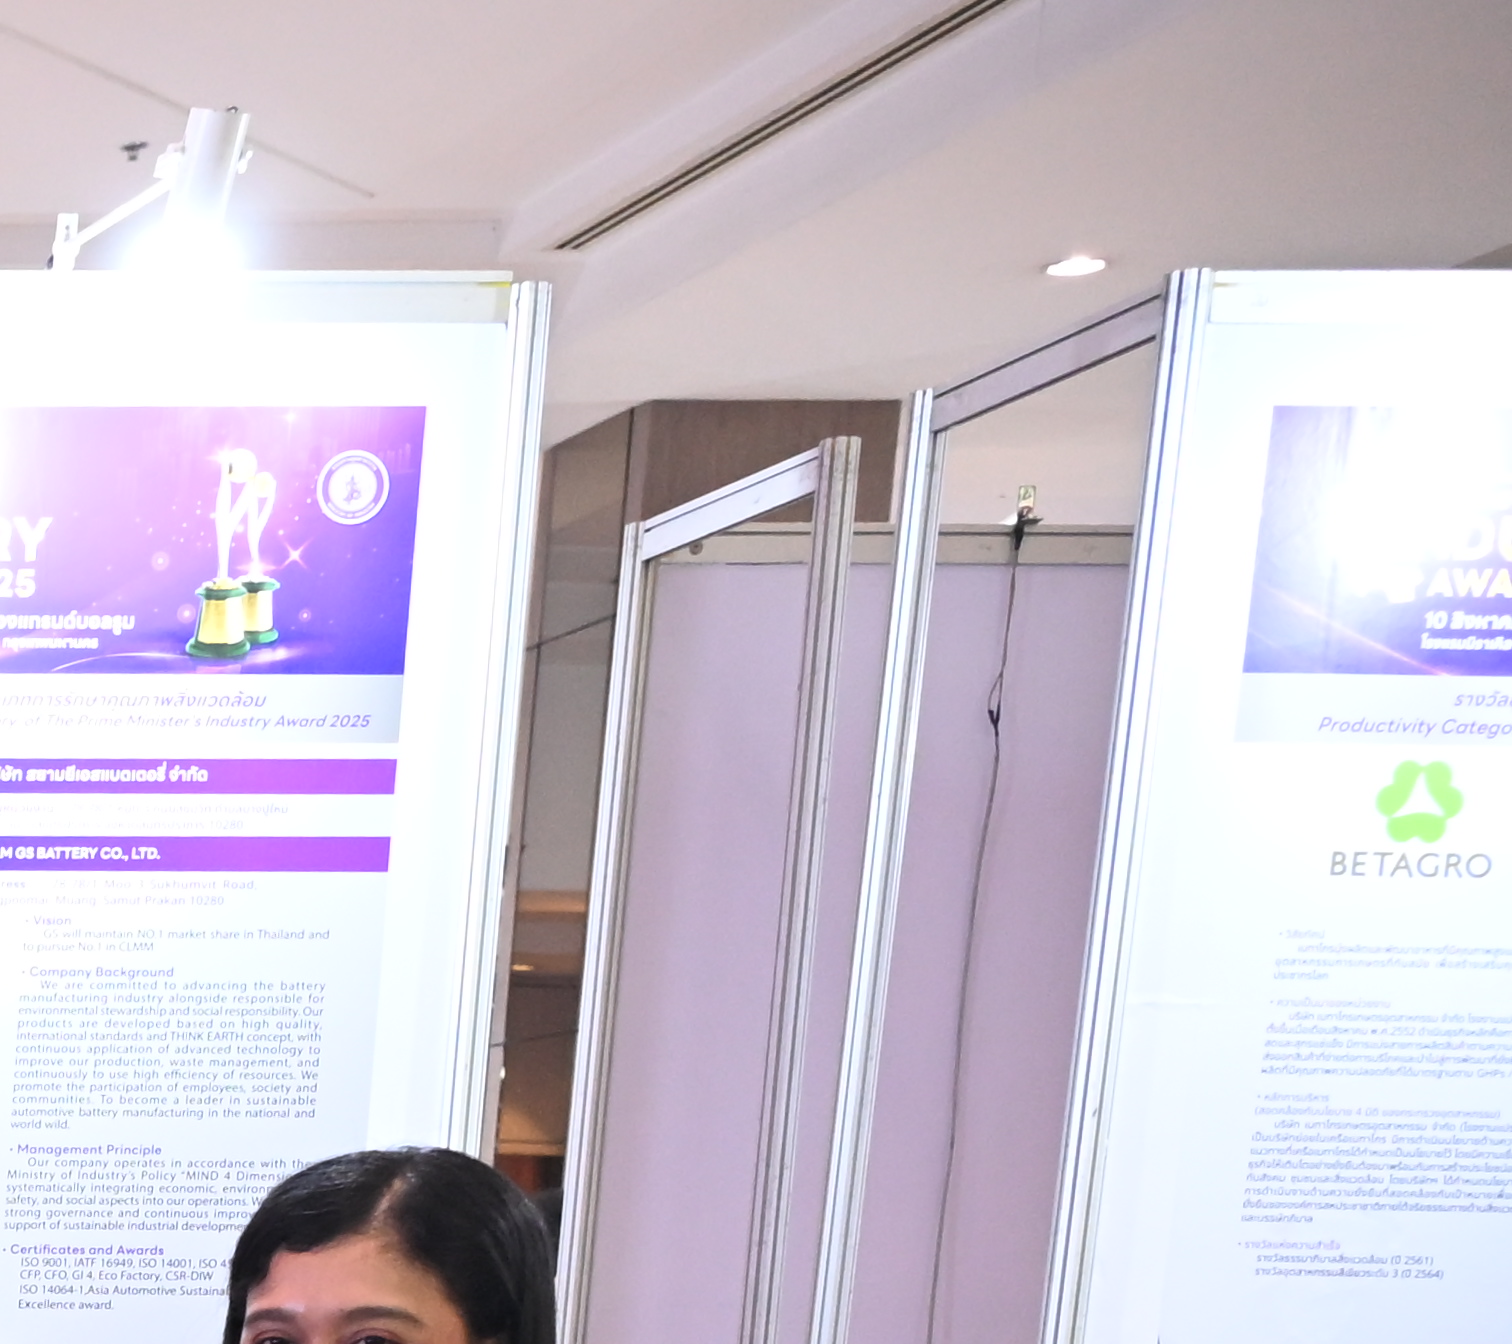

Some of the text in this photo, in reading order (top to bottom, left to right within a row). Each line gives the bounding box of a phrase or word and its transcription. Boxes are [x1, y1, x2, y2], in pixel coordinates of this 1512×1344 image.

[1426, 568, 1512, 598] AWA
[1424, 610, 1512, 629] 10 สิงหาค
[25, 712, 41, 728] of
[45, 714, 73, 728] The
[78, 714, 122, 728] Prime
[126, 714, 201, 728] Minister's
[206, 714, 270, 732] Industry
[275, 714, 326, 728] Award
[330, 714, 371, 728] 2025
[1318, 716, 1512, 738] Productivity Catego
[15, 847, 34, 859] GS
[37, 847, 98, 859] BATTERY
[100, 847, 128, 861] CO.,
[131, 847, 160, 859] LTD.
[1330, 851, 1493, 879] BETAGRO
[30, 967, 174, 979] Company Background
[17, 1031, 321, 1043] international standards and THINK EARTH concept, with
[13, 1095, 90, 1104] communities.
[101, 1095, 113, 1104] To
[120, 1095, 167, 1105] become
[186, 1095, 223, 1105] leader
[230, 1096, 240, 1104] in
[247, 1095, 316, 1105] sustainable
[18, 1144, 161, 1156] Management Principle
[11, 1244, 164, 1255] Certificates and Awards
[20, 1257, 217, 1269] ISO 9001, IATF 16949, ISO 14001, ISO
[20, 1270, 214, 1282] CFP, CFO, GI 4, Eco Factory, CSR-DIW
[20, 1284, 38, 1294] ISO
[112, 1285, 177, 1295] Automotive
[18, 1299, 113, 1309] Excellence award.
